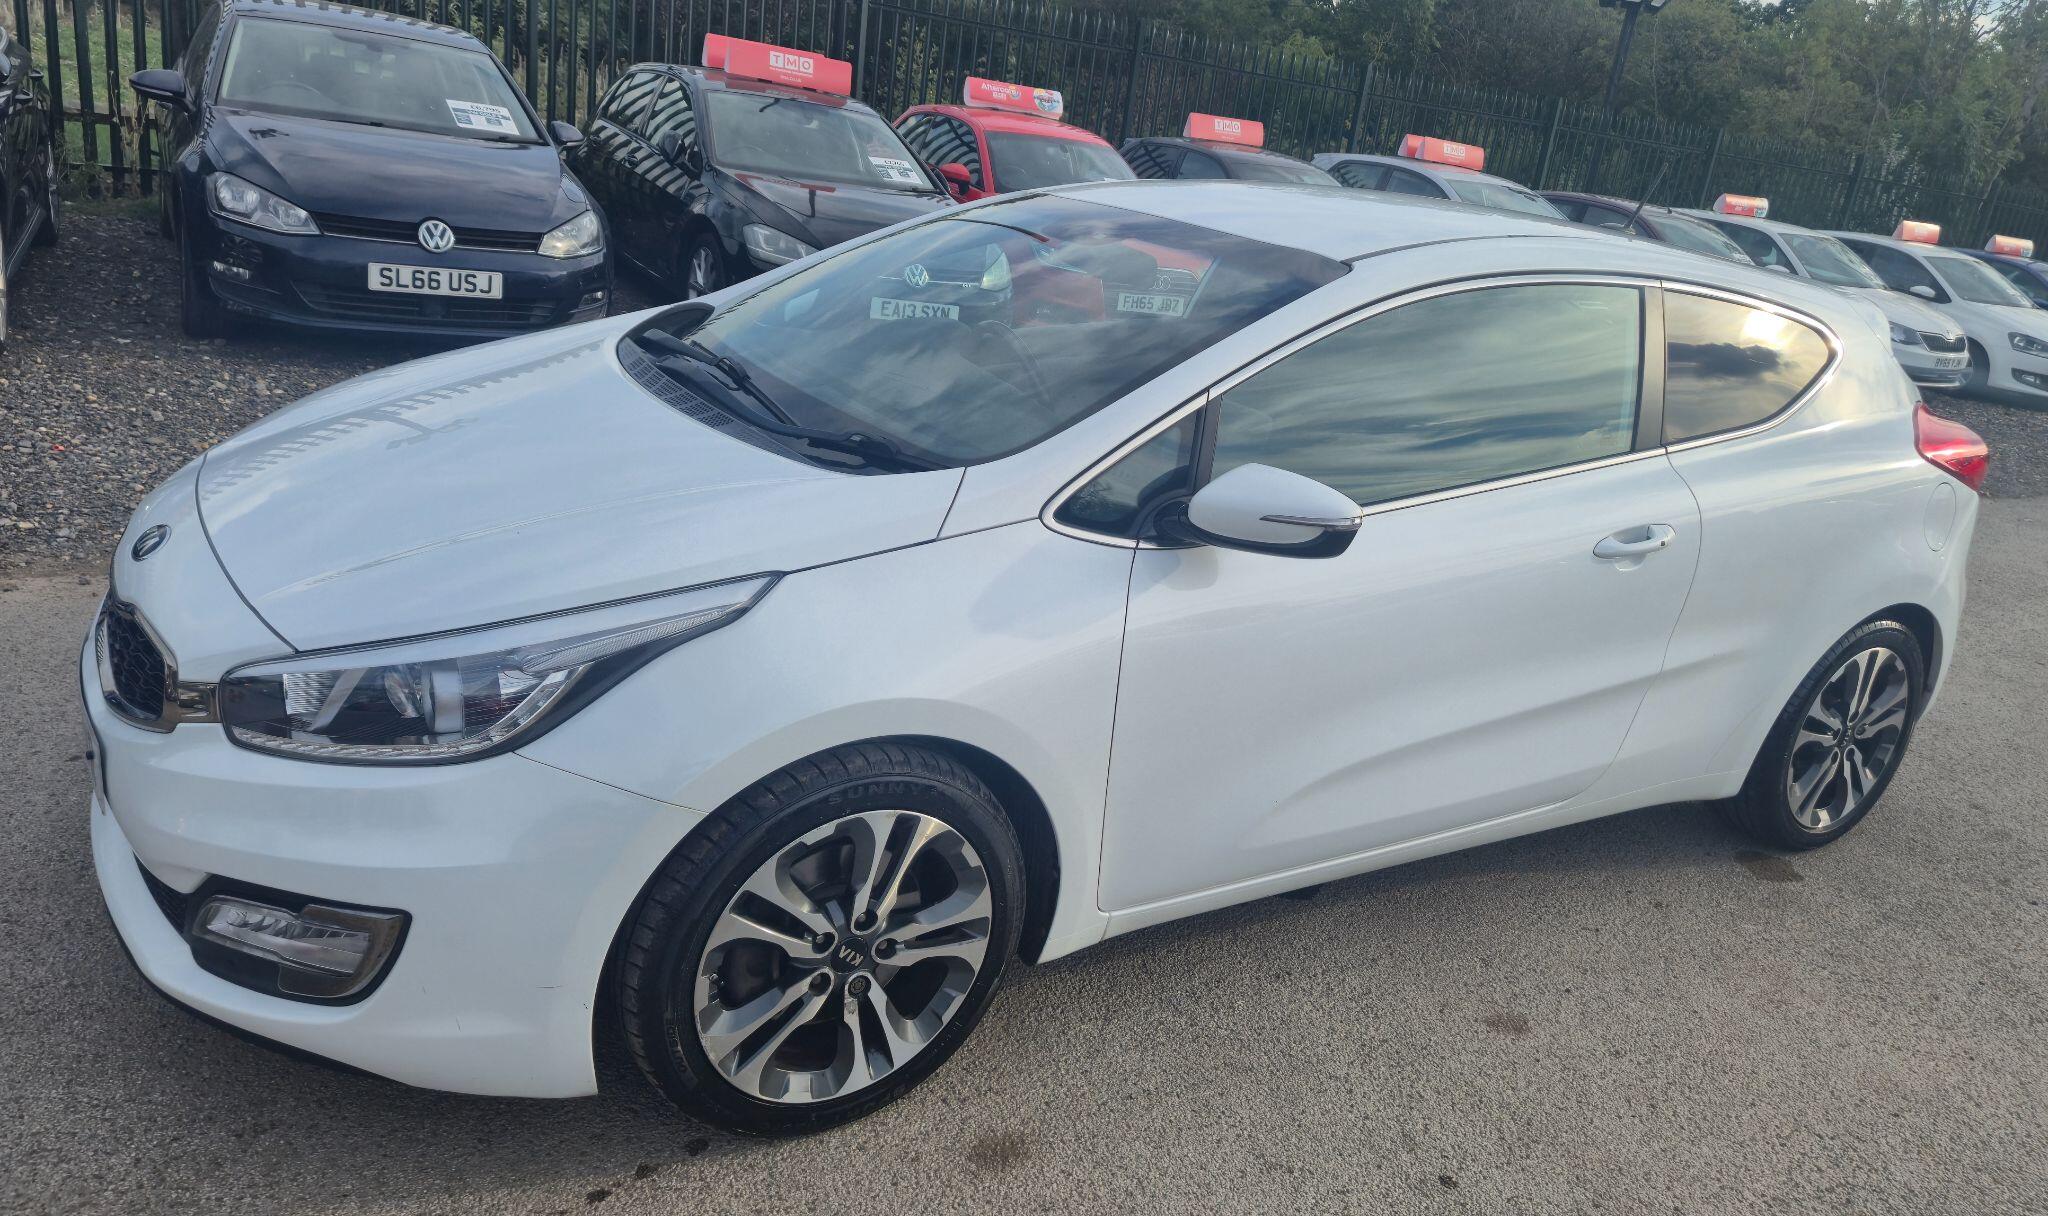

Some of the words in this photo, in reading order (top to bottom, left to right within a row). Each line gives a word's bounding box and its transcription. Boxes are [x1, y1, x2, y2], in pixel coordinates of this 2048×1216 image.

[771, 52, 812, 72] TMO
[380, 267, 441, 290] SL66
[448, 272, 493, 294] USJ
[880, 301, 917, 319] EA13
[921, 305, 951, 319] SYN
[1123, 295, 1154, 310] FH65
[839, 945, 864, 967] KIA
